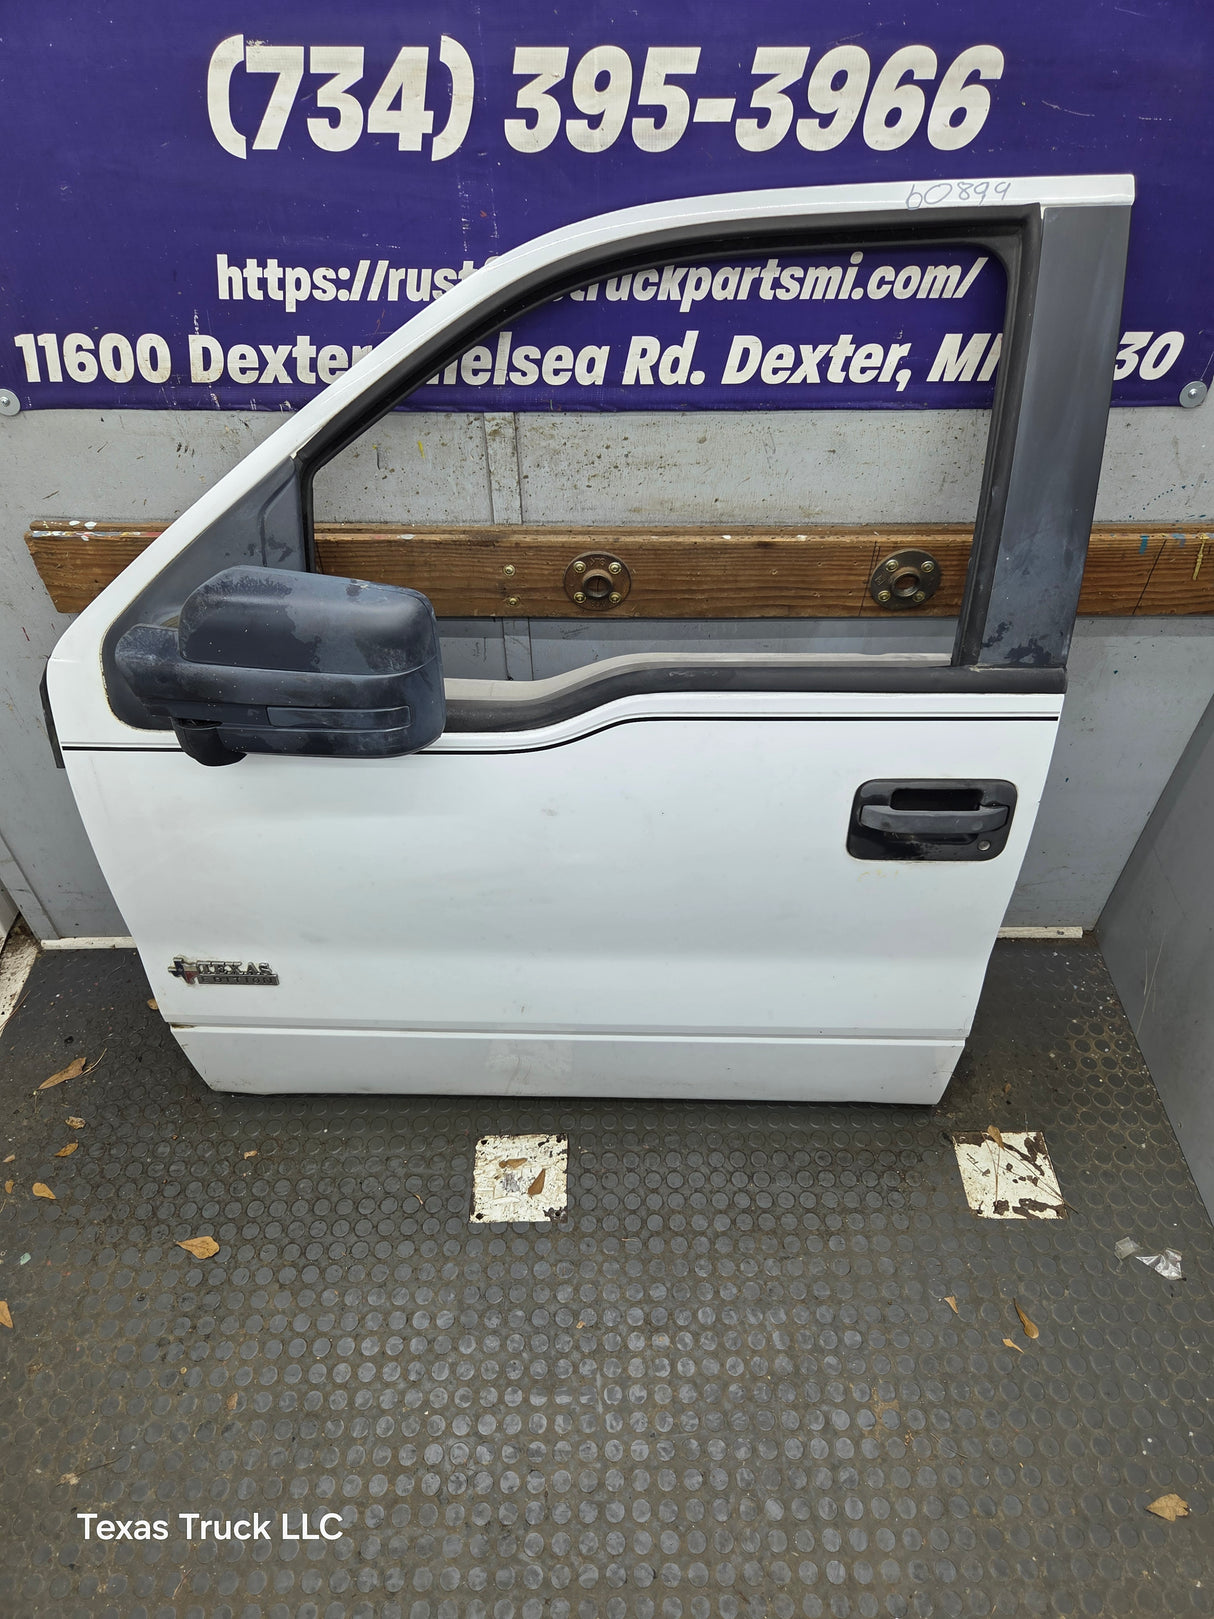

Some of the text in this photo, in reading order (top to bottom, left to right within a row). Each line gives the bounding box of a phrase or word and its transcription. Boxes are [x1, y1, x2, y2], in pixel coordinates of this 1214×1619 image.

[207, 34, 1004, 161] (734) 395-3966
[14, 333, 172, 383] 11600
[426, 331, 610, 386] elsea
[622, 331, 705, 385] Rd.
[721, 334, 912, 391] Dexter,
[197, 961, 273, 976] TEXAS
